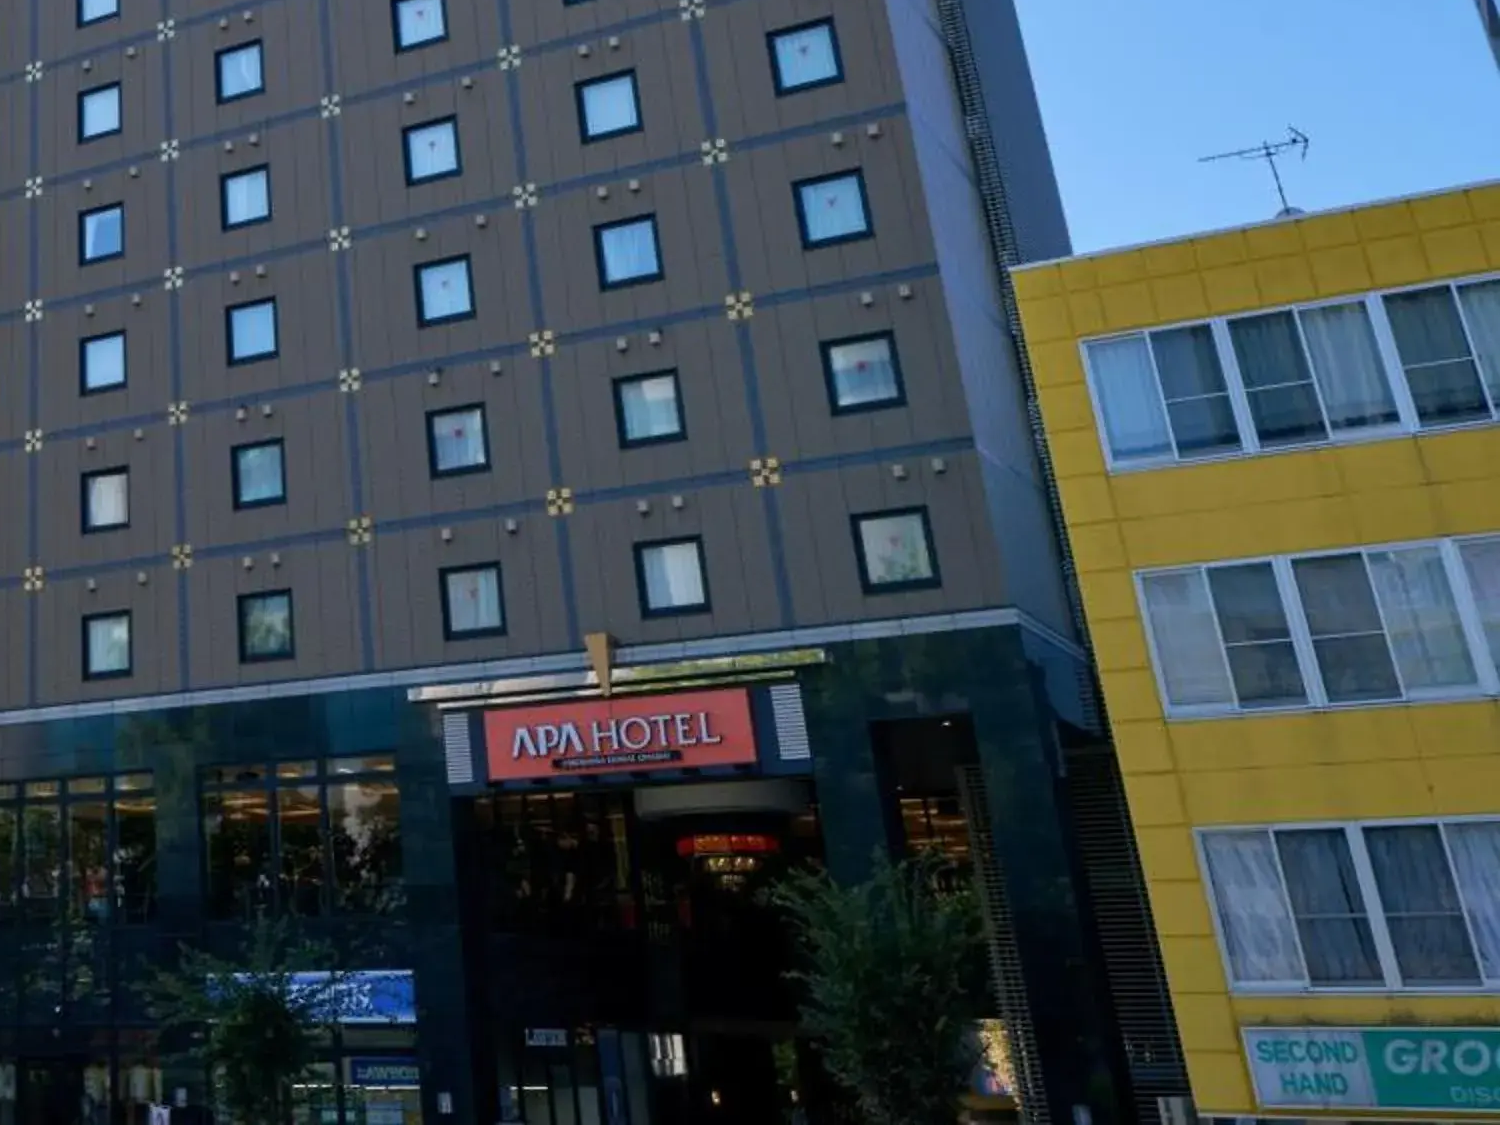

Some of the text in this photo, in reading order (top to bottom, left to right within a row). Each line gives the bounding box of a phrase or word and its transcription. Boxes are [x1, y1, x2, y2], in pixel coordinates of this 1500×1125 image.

[511, 711, 722, 758] APA HOTEL
[1256, 1040, 1358, 1064] SECOND
[1384, 1038, 1500, 1076] GRO
[1280, 1073, 1349, 1096] HAND
